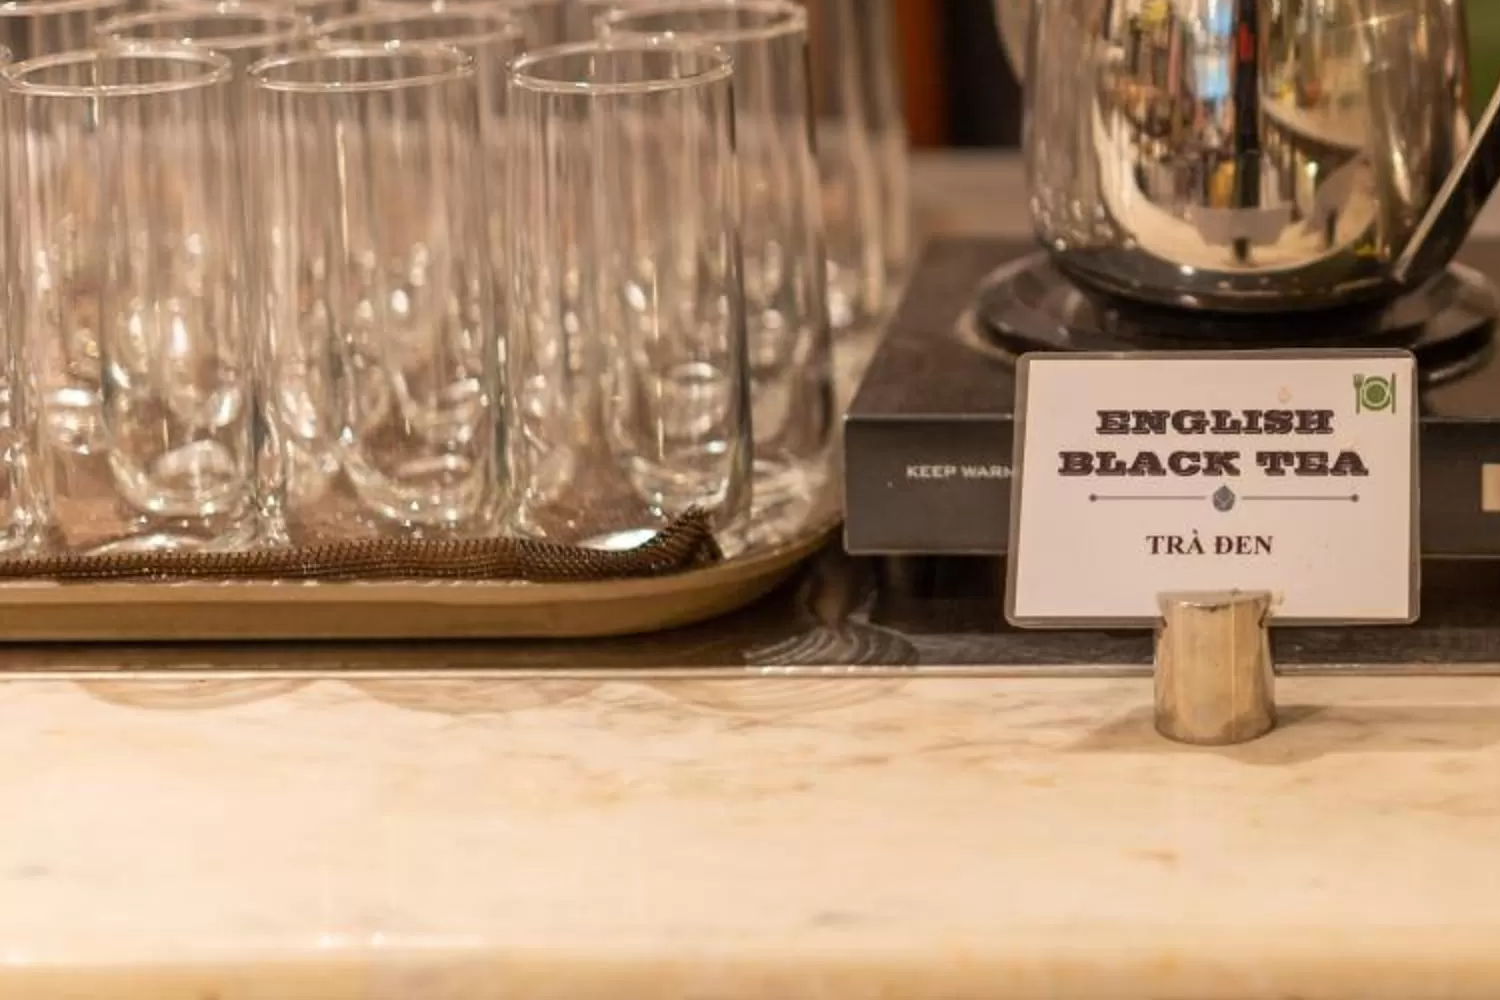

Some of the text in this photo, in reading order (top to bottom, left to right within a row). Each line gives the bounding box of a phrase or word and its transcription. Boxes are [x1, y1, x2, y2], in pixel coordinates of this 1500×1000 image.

[1095, 409, 1335, 435] ENGLISH
[906, 465, 957, 478] KEEP
[1057, 450, 1369, 477] BLACK TEA
[1145, 529, 1273, 555] TRÀ ĐEN
